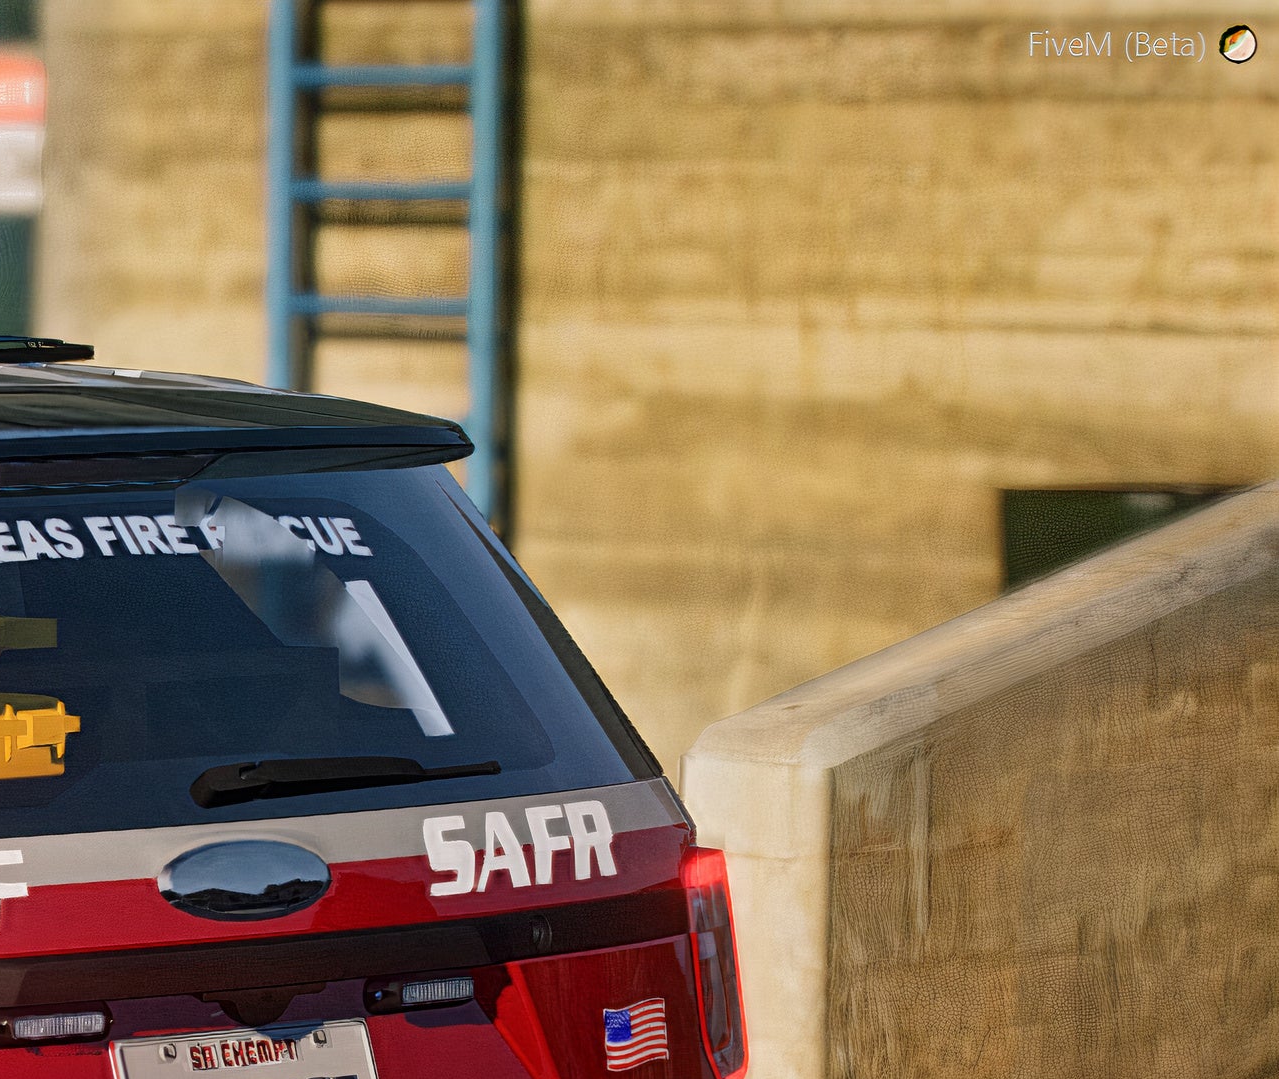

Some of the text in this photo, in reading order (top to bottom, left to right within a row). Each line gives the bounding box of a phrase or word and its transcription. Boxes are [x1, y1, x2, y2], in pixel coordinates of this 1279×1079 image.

[81, 514, 202, 557] FIRE
[198, 515, 374, 558] RCUE
[428, 800, 618, 897] SAFR
